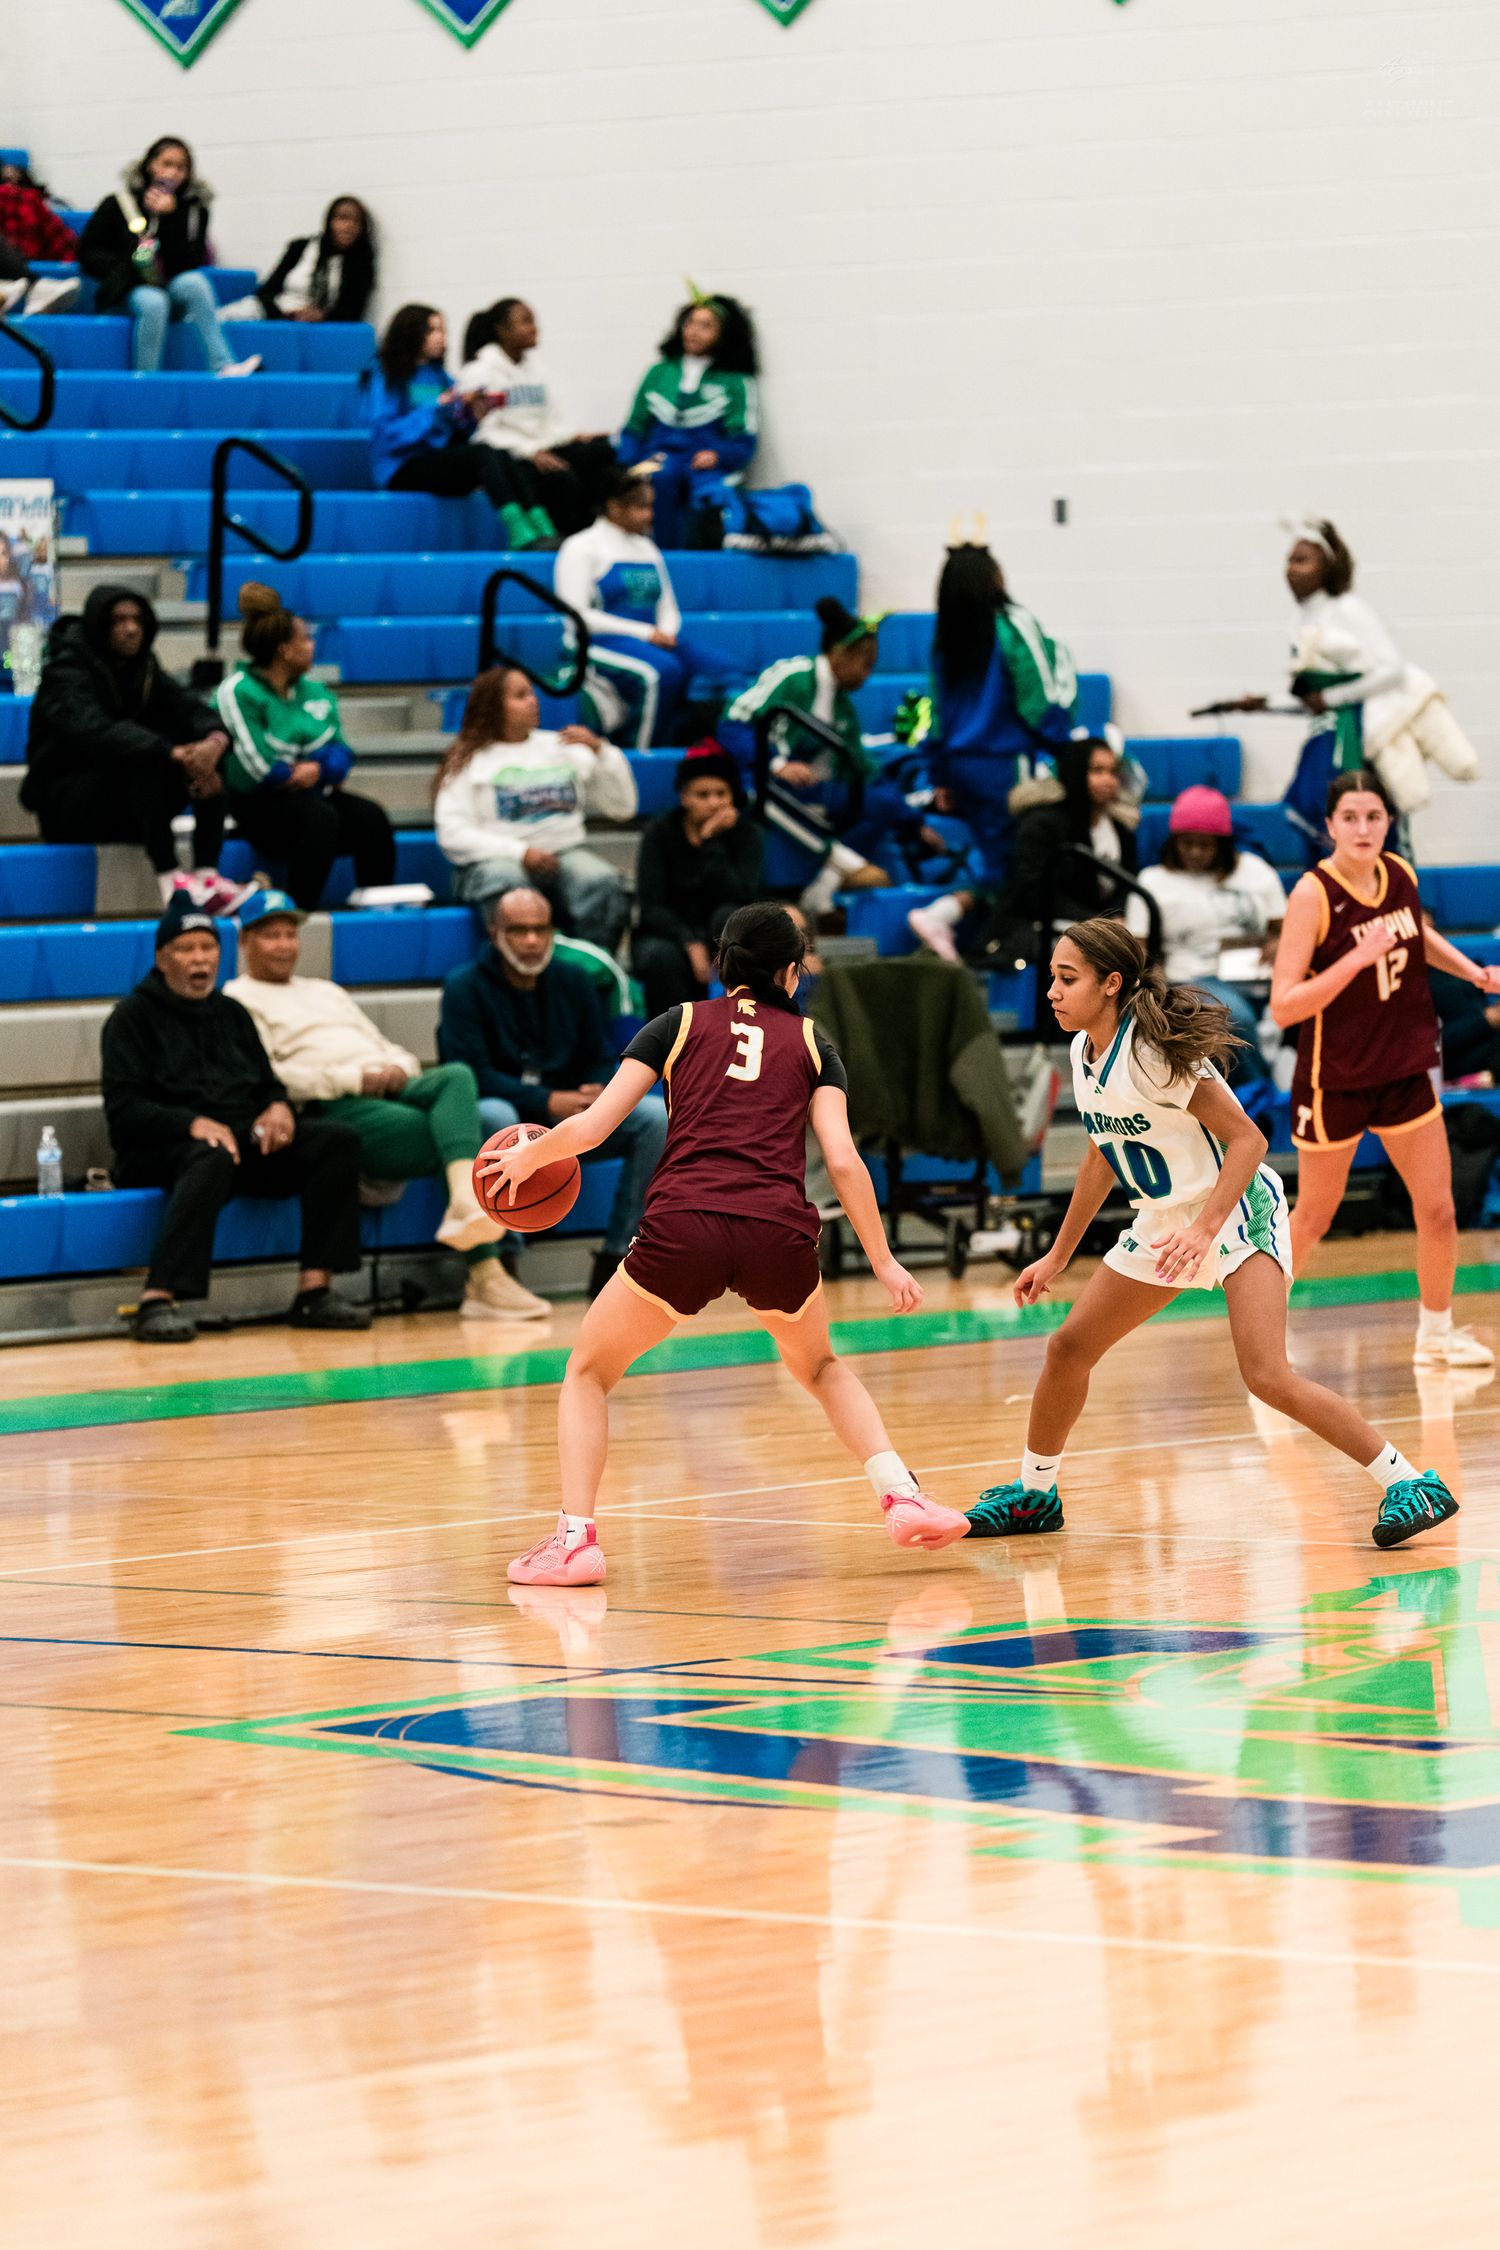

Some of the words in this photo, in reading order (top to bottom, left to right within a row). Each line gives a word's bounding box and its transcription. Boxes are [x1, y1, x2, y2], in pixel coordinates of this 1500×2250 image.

[1376, 947, 1409, 1002] 12
[725, 1021, 765, 1082] 3
[1098, 1140, 1172, 1201] 10
